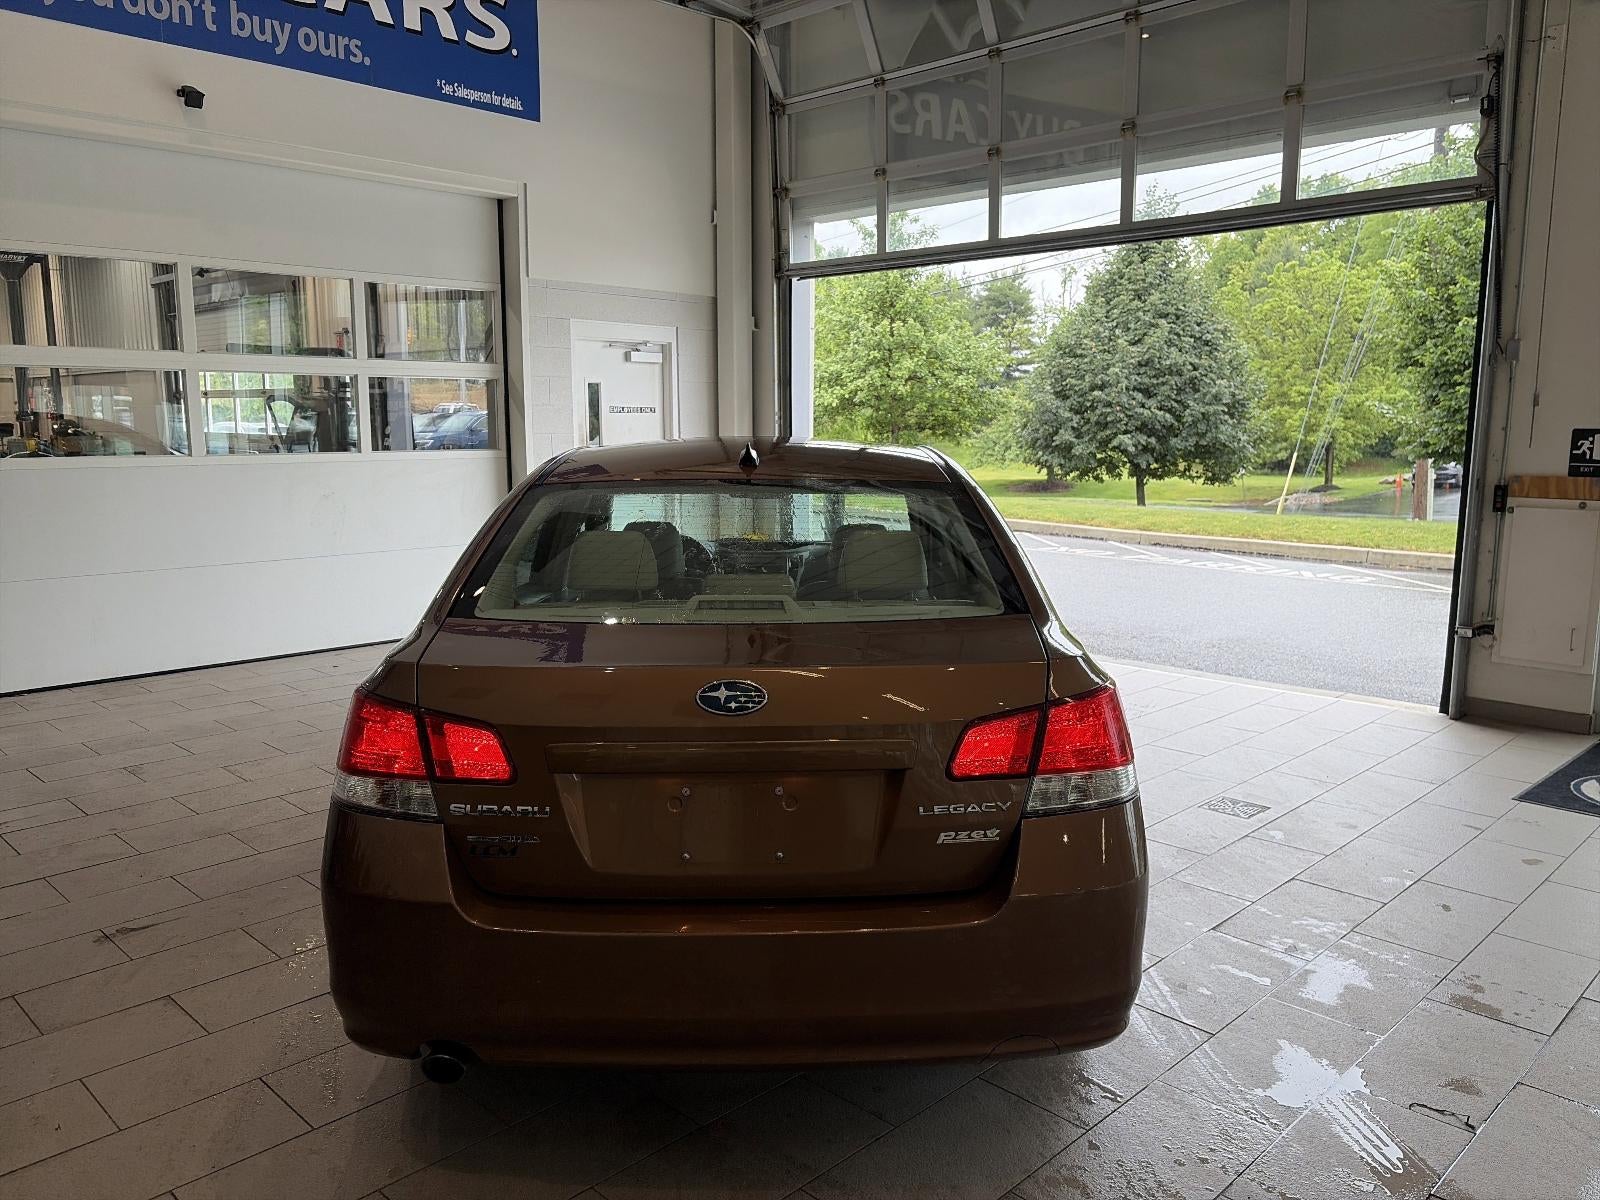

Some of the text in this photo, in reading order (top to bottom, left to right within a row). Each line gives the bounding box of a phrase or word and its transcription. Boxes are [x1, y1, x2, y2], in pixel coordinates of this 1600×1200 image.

[229, 0, 292, 55] buy
[297, 26, 371, 66] ours.
[283, 0, 518, 56] RS.
[441, 80, 524, 111] See Salesperson for details.
[449, 803, 550, 817] SUBARU
[918, 801, 1012, 815] LEGACY
